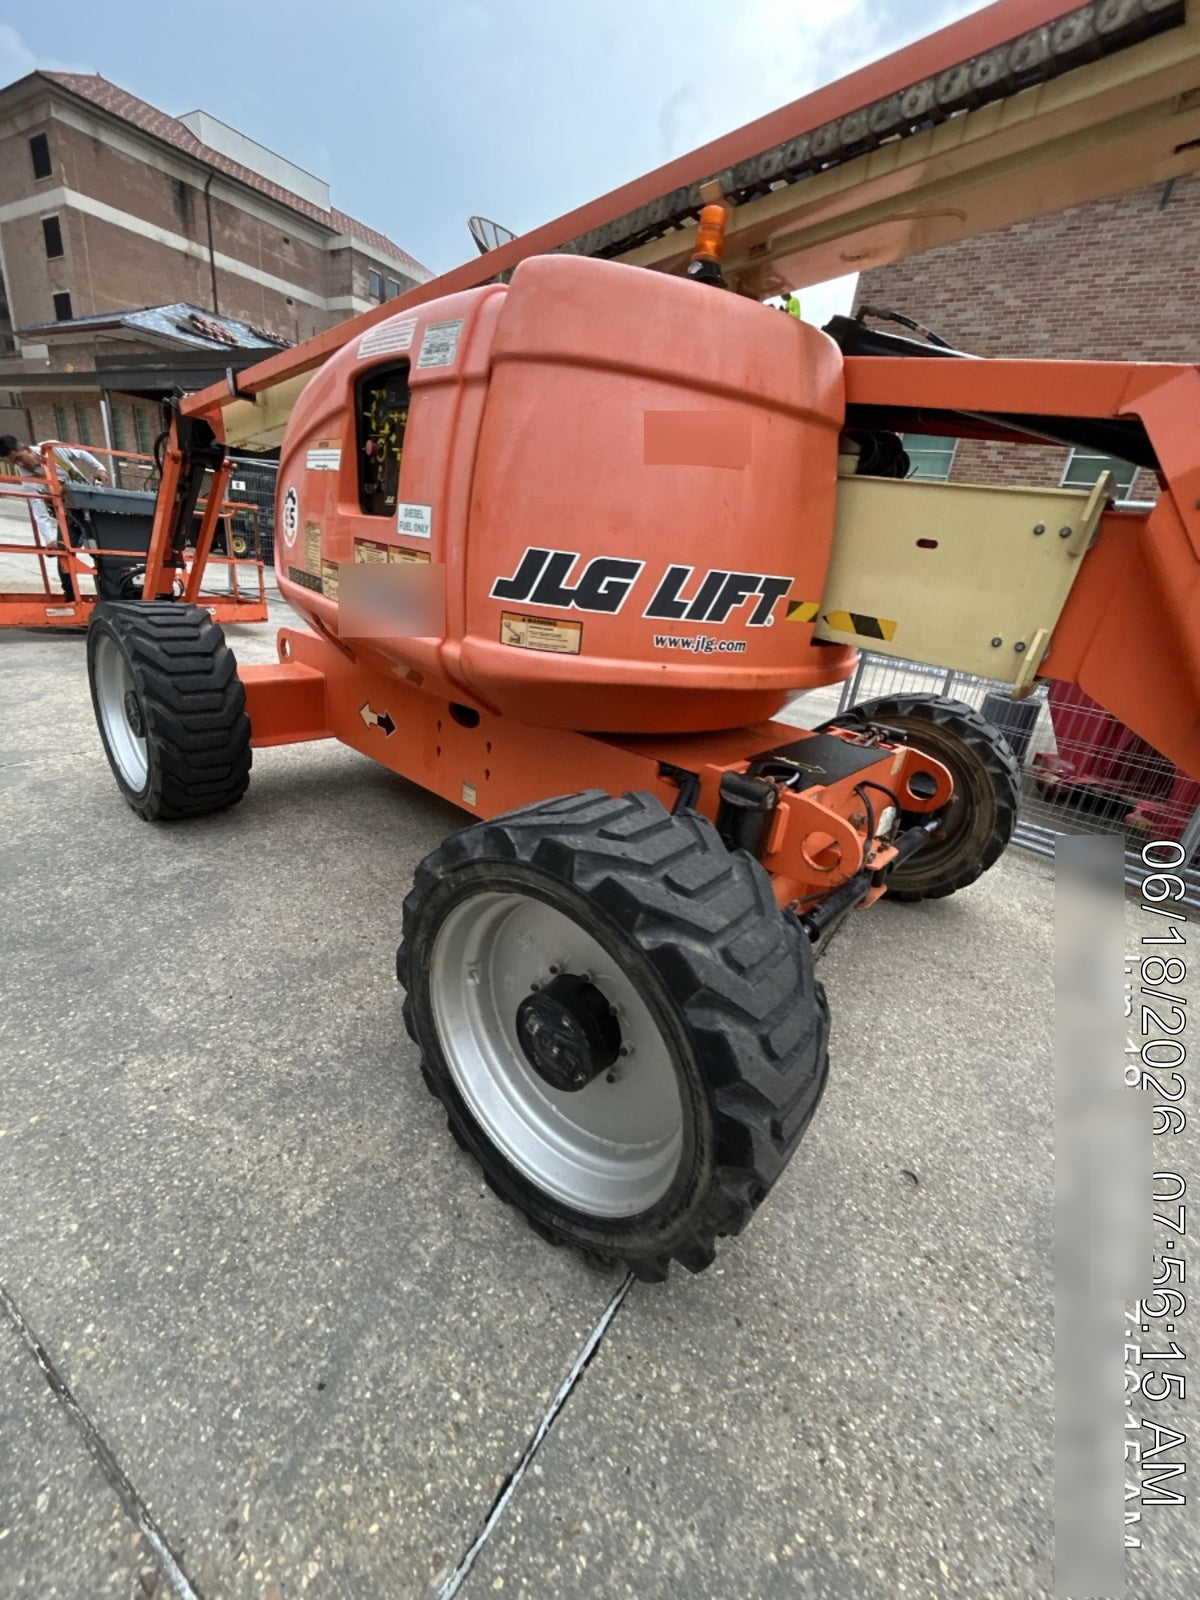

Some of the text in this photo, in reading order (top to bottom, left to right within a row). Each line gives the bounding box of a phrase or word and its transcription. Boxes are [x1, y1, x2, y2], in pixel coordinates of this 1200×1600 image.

[404, 508, 424, 519] DIESEL
[399, 520, 429, 534] FUEL ONLY
[489, 547, 645, 615] JLG
[653, 635, 747, 653] www.jlg.com
